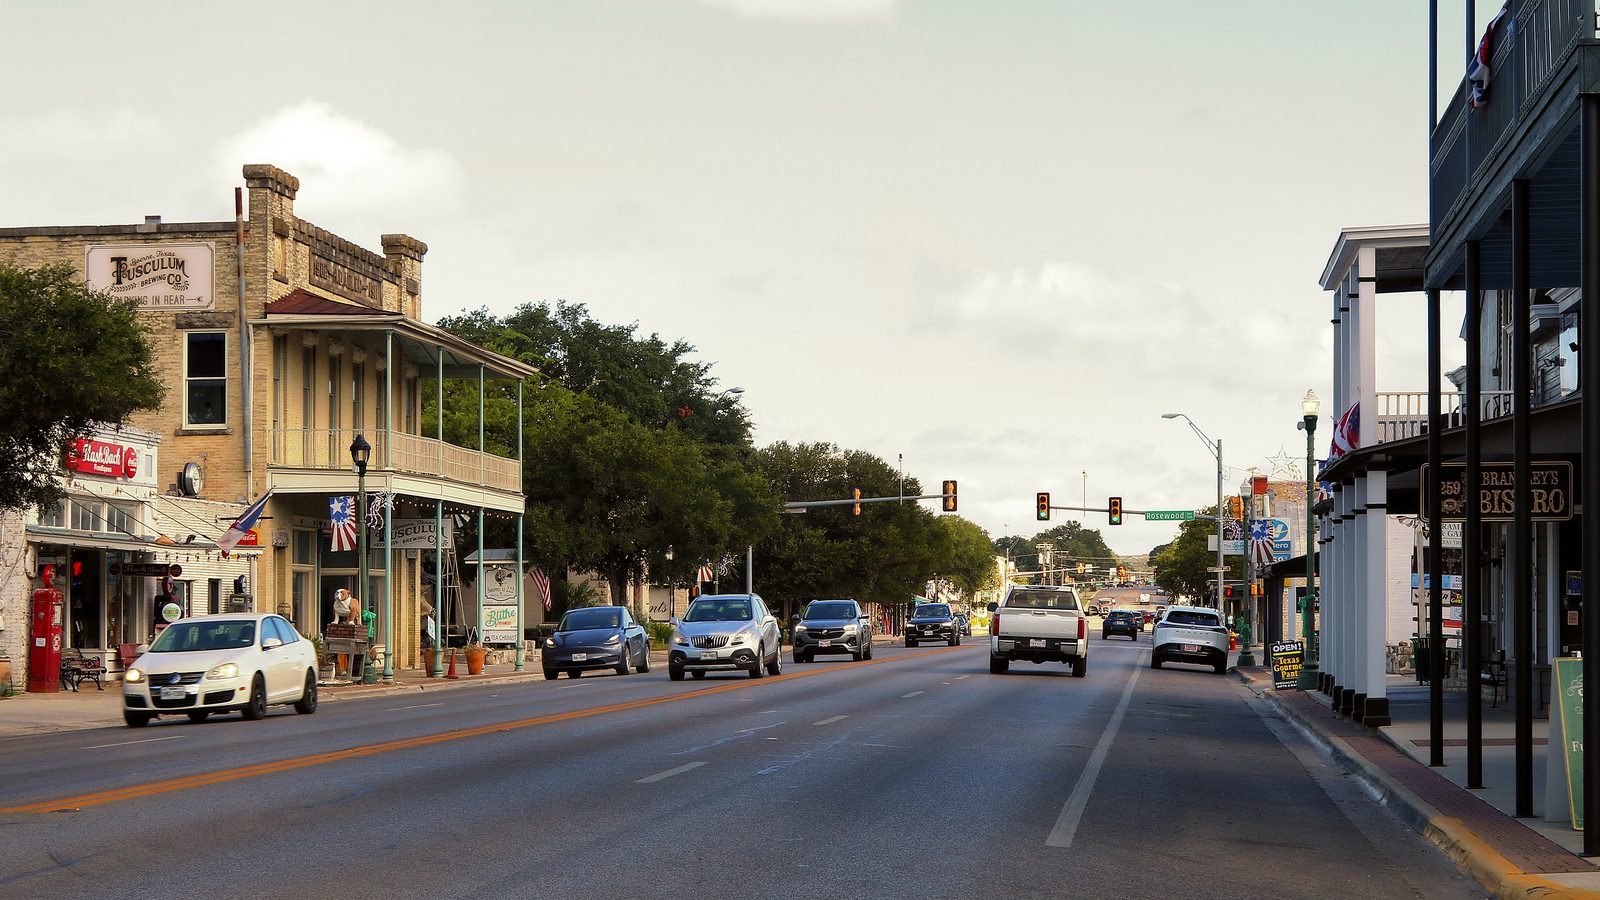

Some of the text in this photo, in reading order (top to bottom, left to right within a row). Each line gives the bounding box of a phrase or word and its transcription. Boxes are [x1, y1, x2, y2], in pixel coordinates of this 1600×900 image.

[111, 256, 189, 285] TUSCULUM
[140, 274, 167, 287] BREWING
[152, 295, 161, 305] IN
[164, 295, 185, 305] REAR
[1481, 471, 1559, 486] BRANEY'S
[1480, 488, 1565, 514] BISRO
[1146, 511, 1185, 520] Rosewood
[402, 535, 427, 544] BREWING
[1273, 541, 1289, 549] lero
[485, 608, 516, 627] Blithe
[1278, 656, 1300, 665] Texas
[1273, 663, 1304, 673] Gourme
[1281, 670, 1299, 678] Pant
